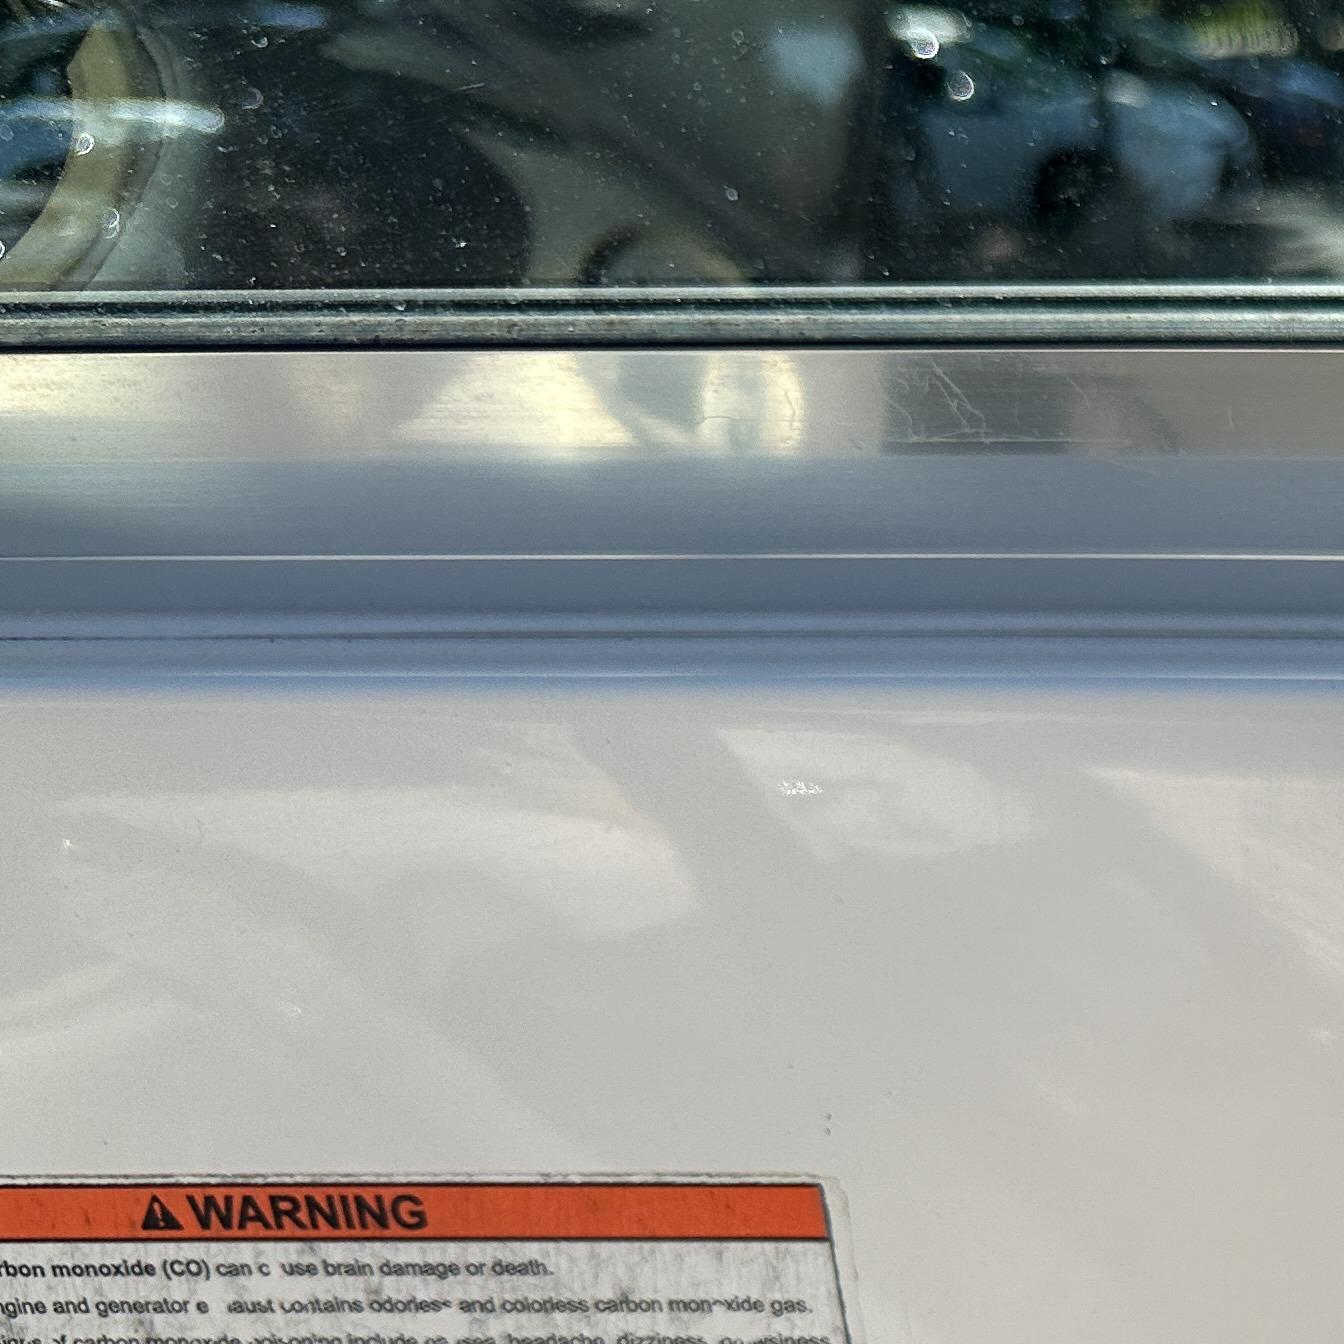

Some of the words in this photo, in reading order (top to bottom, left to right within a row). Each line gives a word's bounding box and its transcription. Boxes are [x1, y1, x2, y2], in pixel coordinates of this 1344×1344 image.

[186, 1194, 428, 1232] WARNING
[51, 1259, 156, 1278] monoxide
[160, 1258, 211, 1282] (CO)
[214, 1262, 253, 1278] can
[324, 1258, 375, 1278] brain
[377, 1258, 462, 1281] damage
[464, 1262, 487, 1277] or
[490, 1258, 554, 1277] death.
